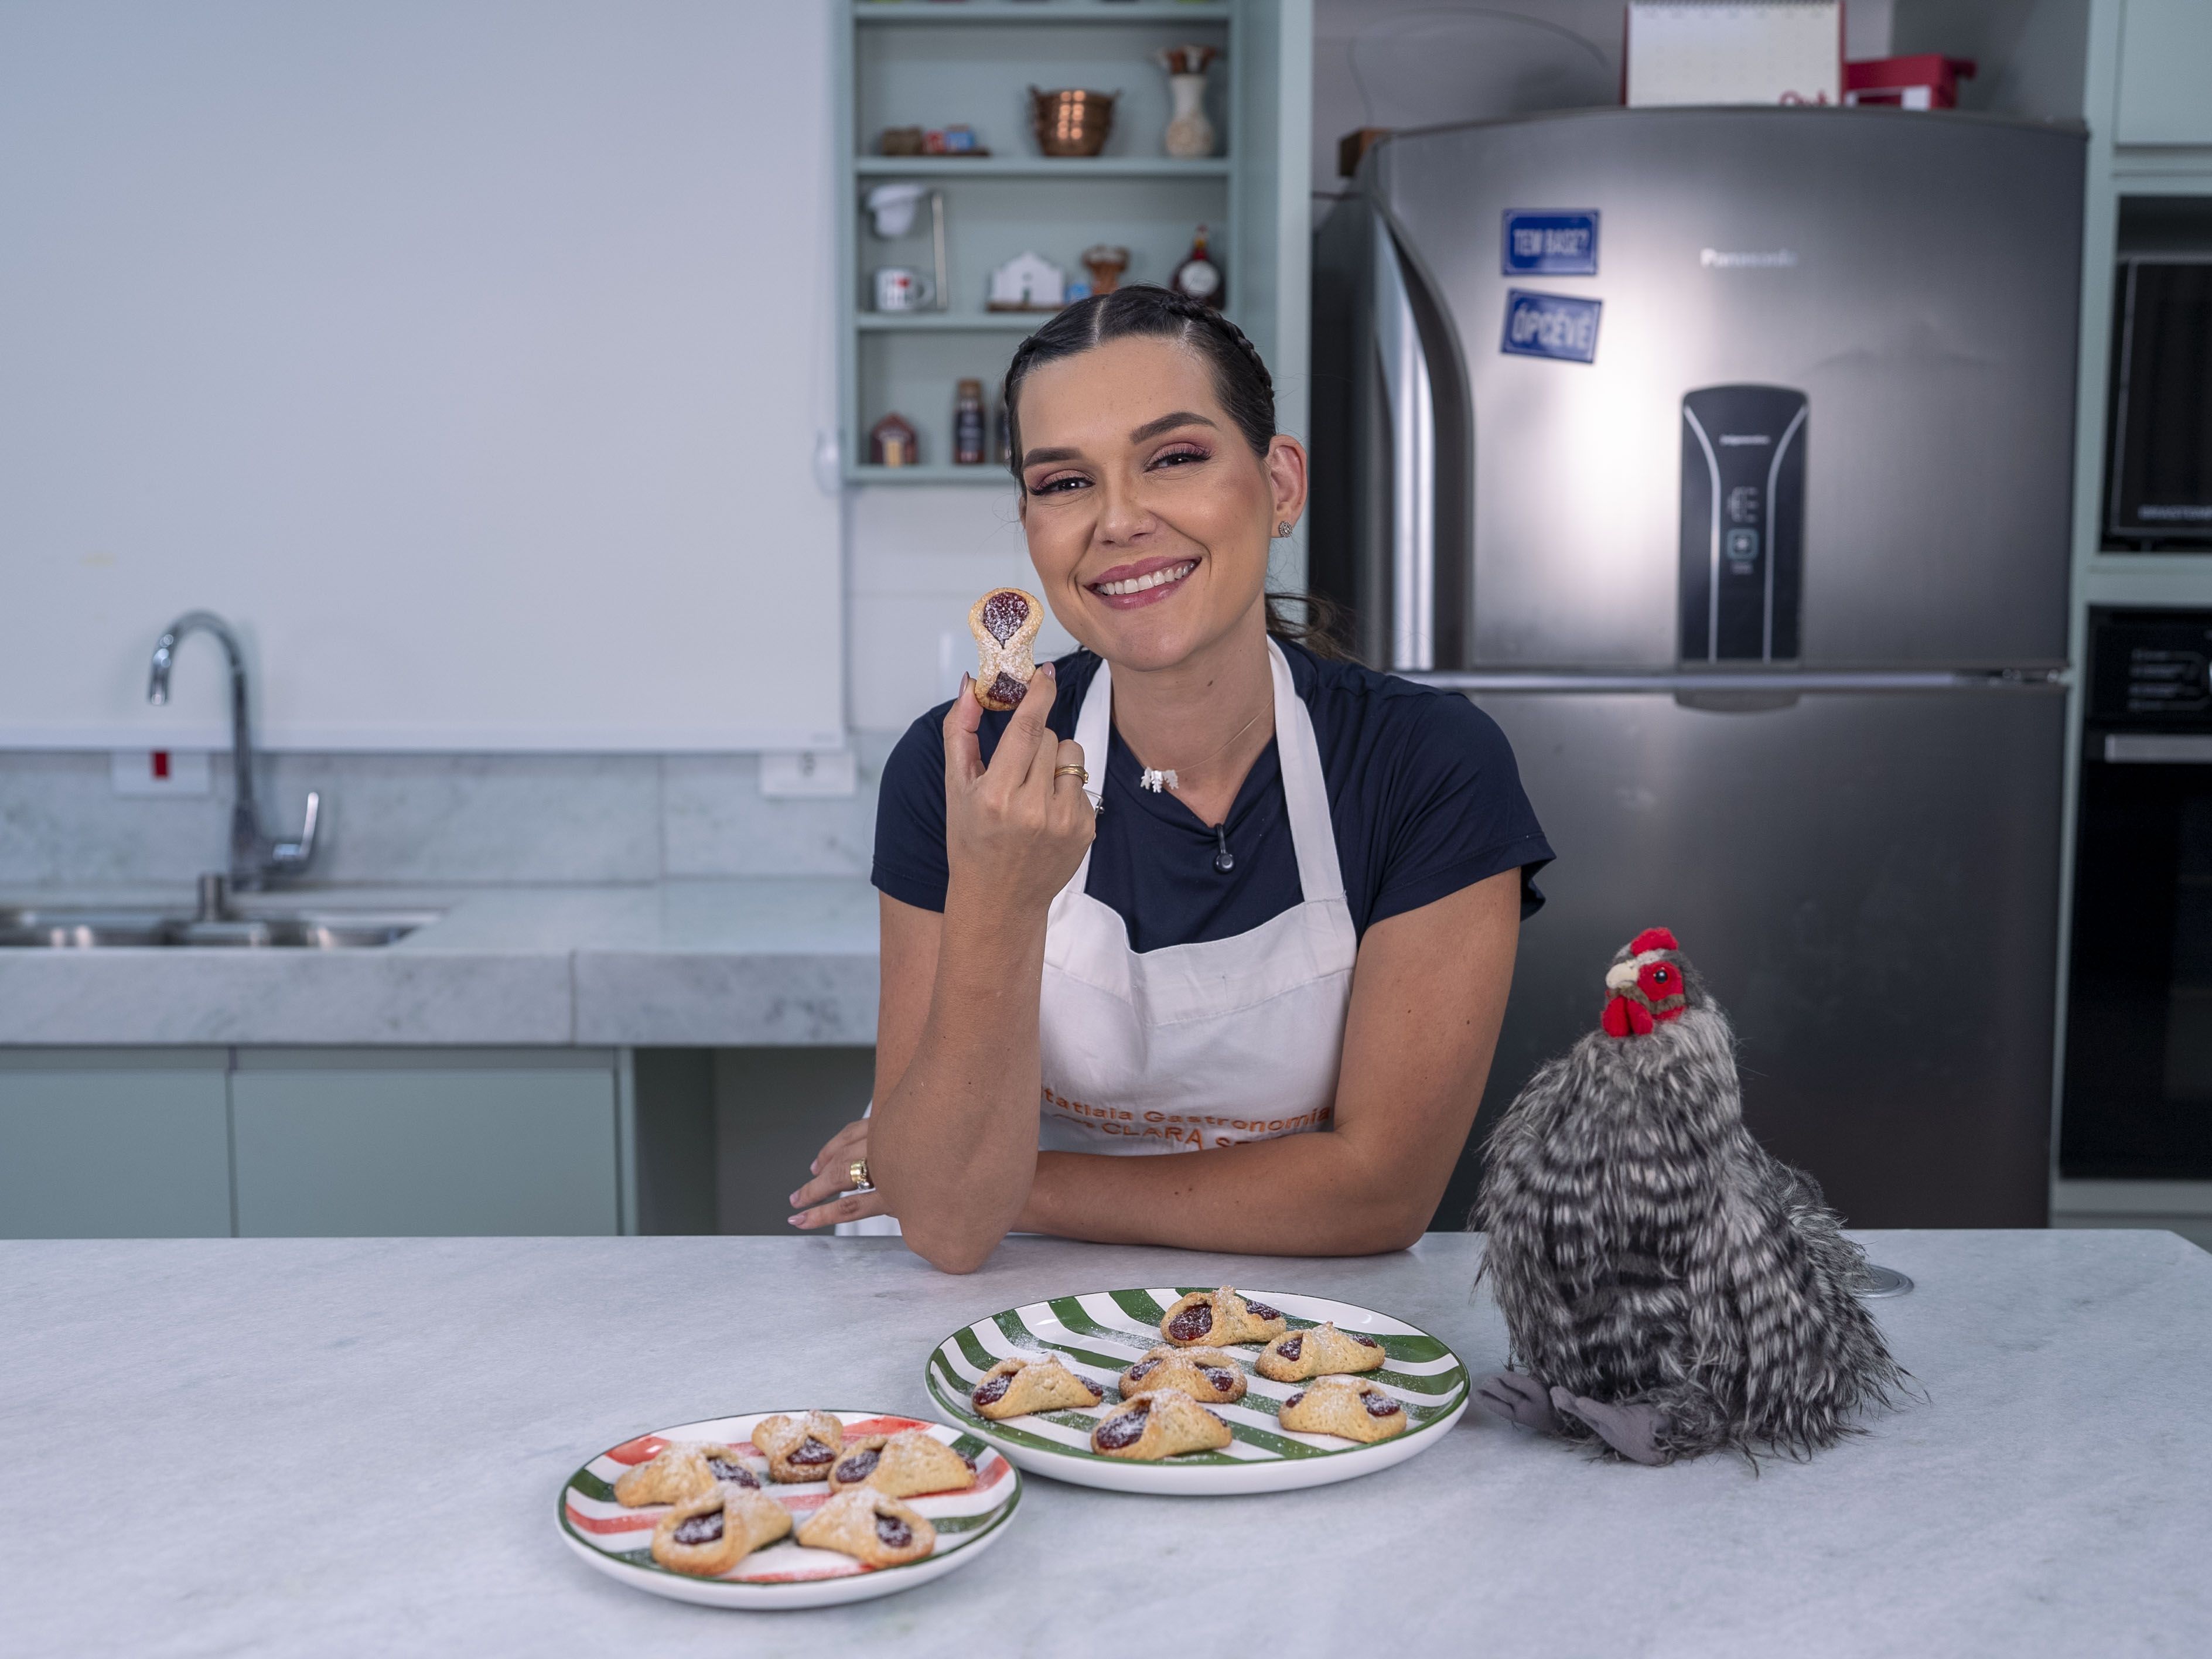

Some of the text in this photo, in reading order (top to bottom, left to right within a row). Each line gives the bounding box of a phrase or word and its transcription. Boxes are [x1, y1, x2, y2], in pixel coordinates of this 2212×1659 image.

[1513, 227, 1589, 255] TEM BASE?
[1041, 1088, 1330, 1132] tatiaia Gastronomia
[1101, 1122, 1203, 1150] CLARA
